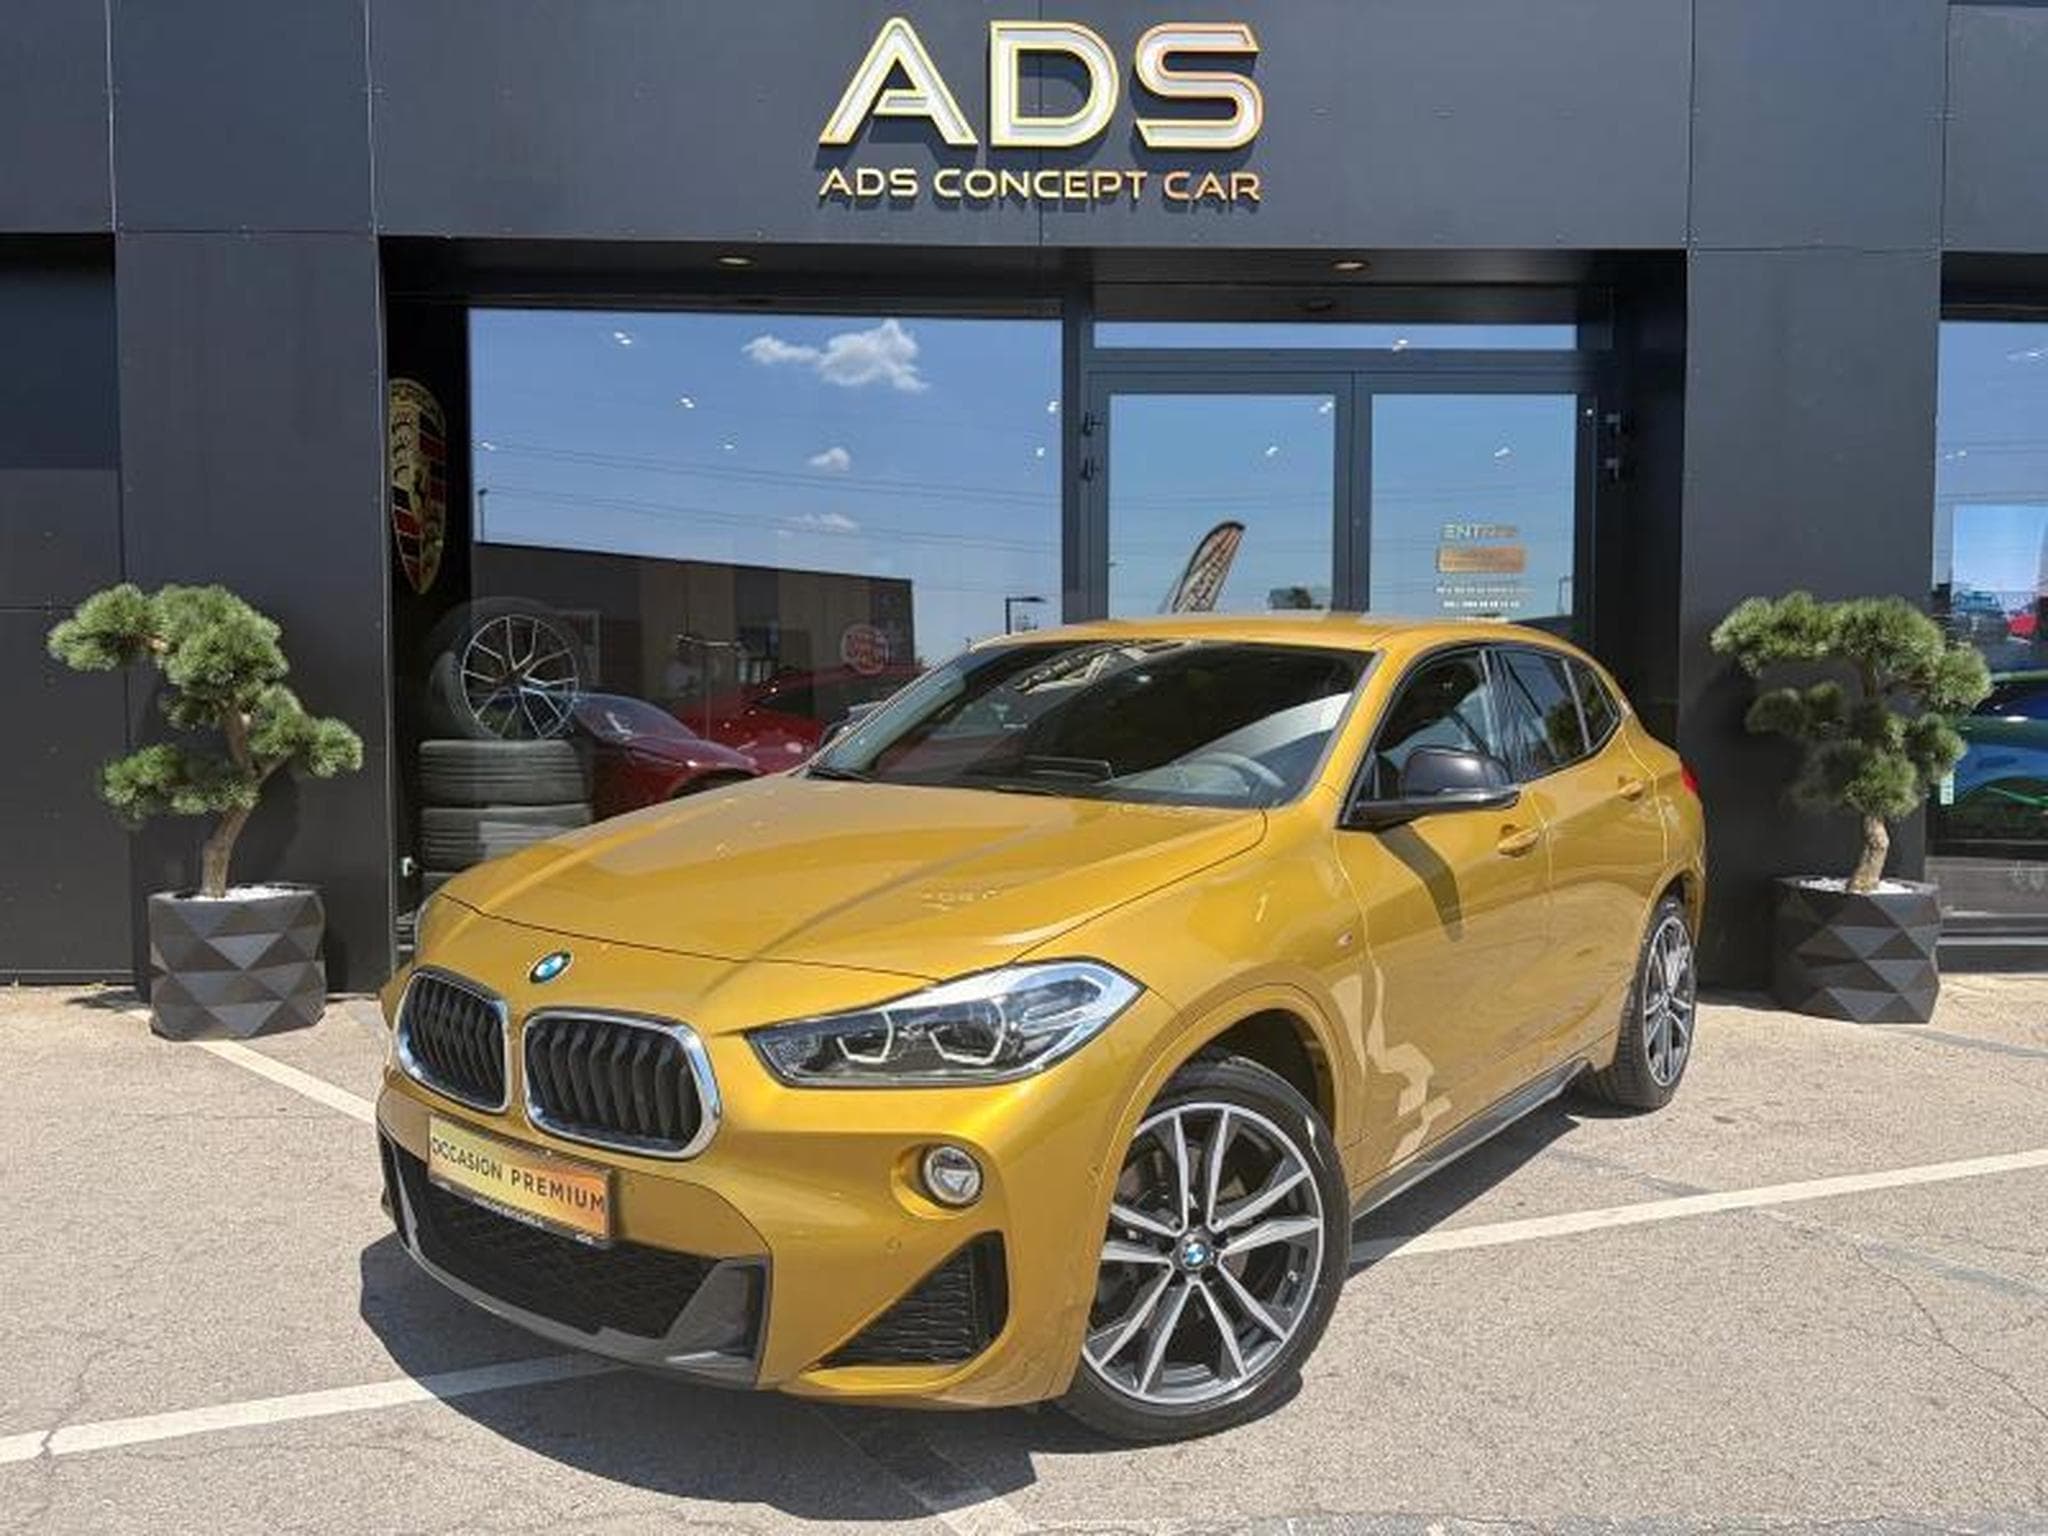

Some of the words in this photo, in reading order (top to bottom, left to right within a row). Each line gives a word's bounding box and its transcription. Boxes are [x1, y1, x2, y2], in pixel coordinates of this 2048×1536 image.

[818, 16, 1264, 149] ADS
[818, 168, 918, 198] ADS
[934, 168, 1148, 199] CONCEPT
[1162, 171, 1262, 201] CAR
[430, 1136, 503, 1180] OCCASION
[511, 1169, 605, 1213] PREMIUM
